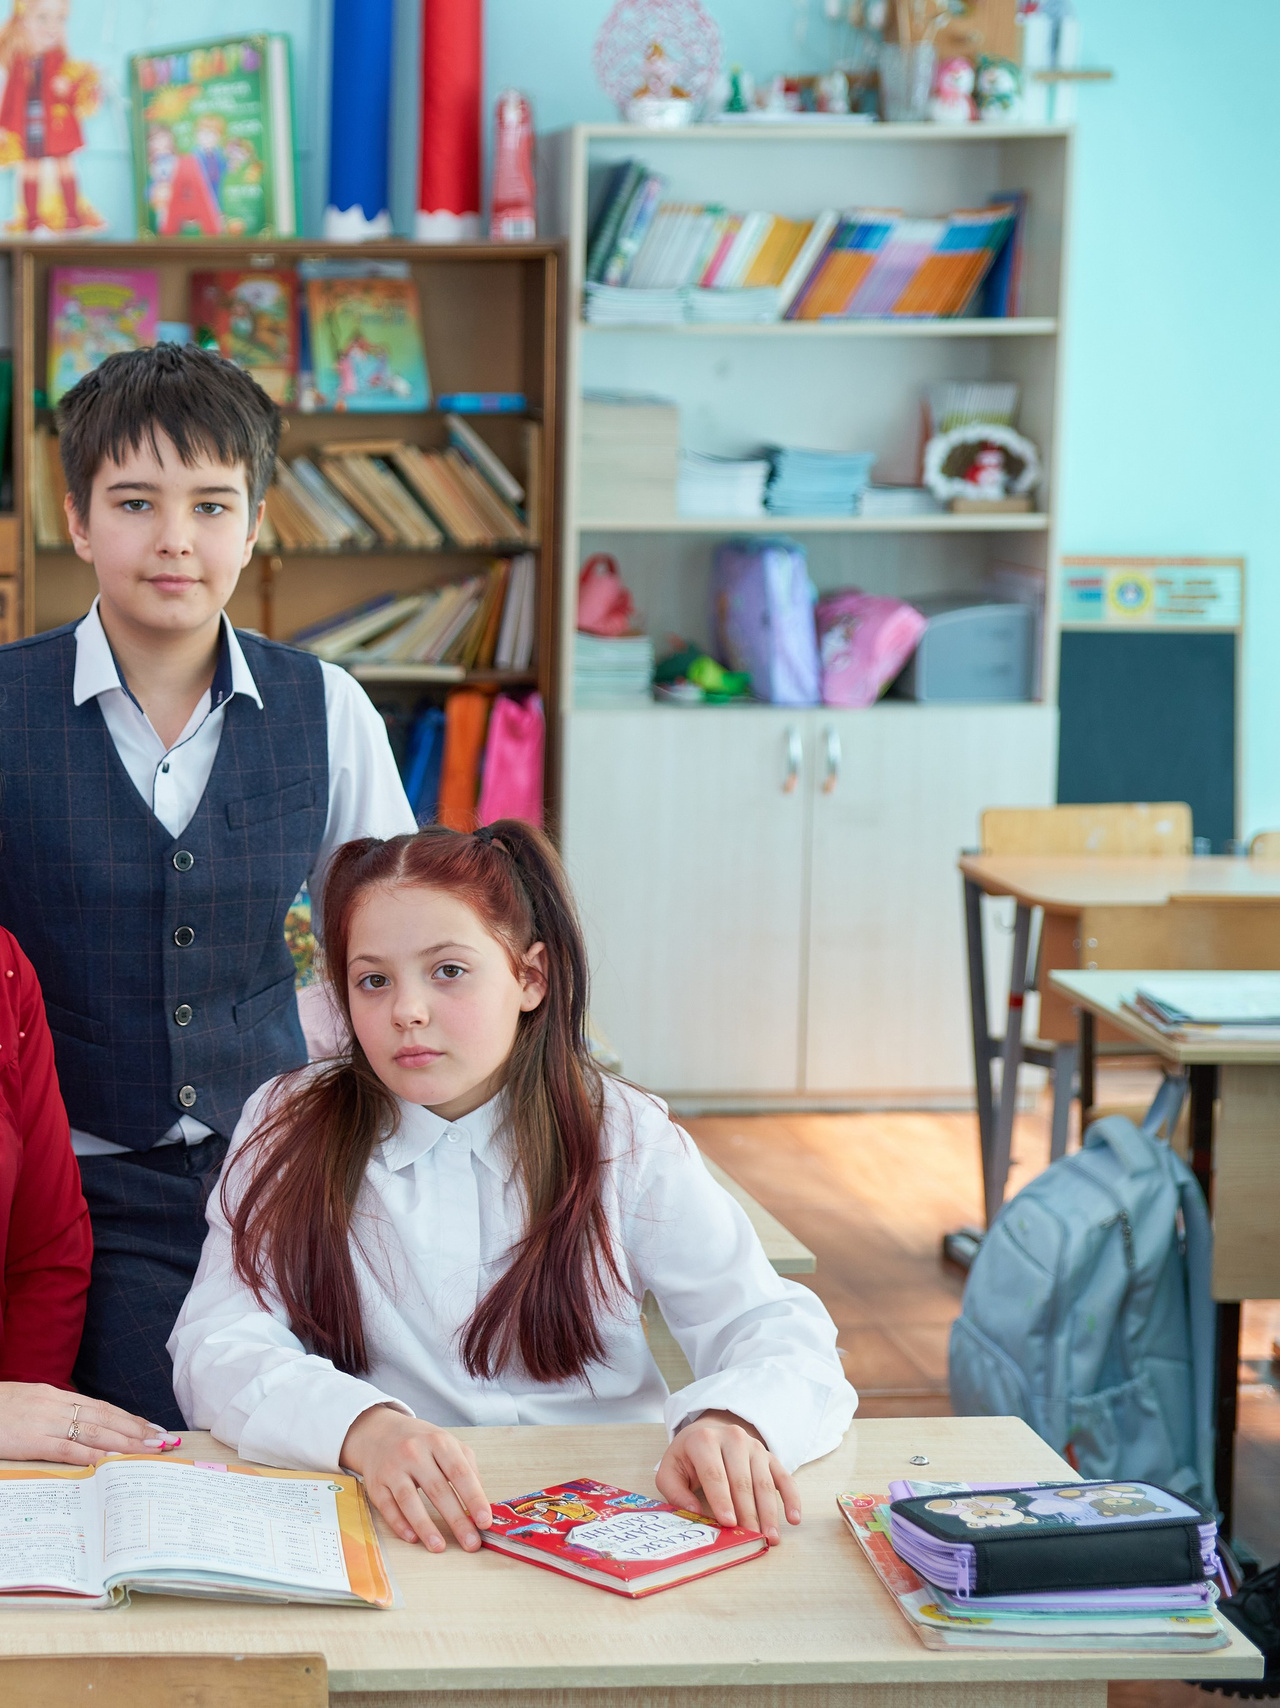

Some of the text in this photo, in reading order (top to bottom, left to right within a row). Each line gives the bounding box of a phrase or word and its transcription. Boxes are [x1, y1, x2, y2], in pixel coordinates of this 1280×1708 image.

[576, 1514, 660, 1540] САЛТАНЕ
[608, 1523, 667, 1543] ЦАРЕ
[623, 1529, 705, 1556] СКАЗКА
